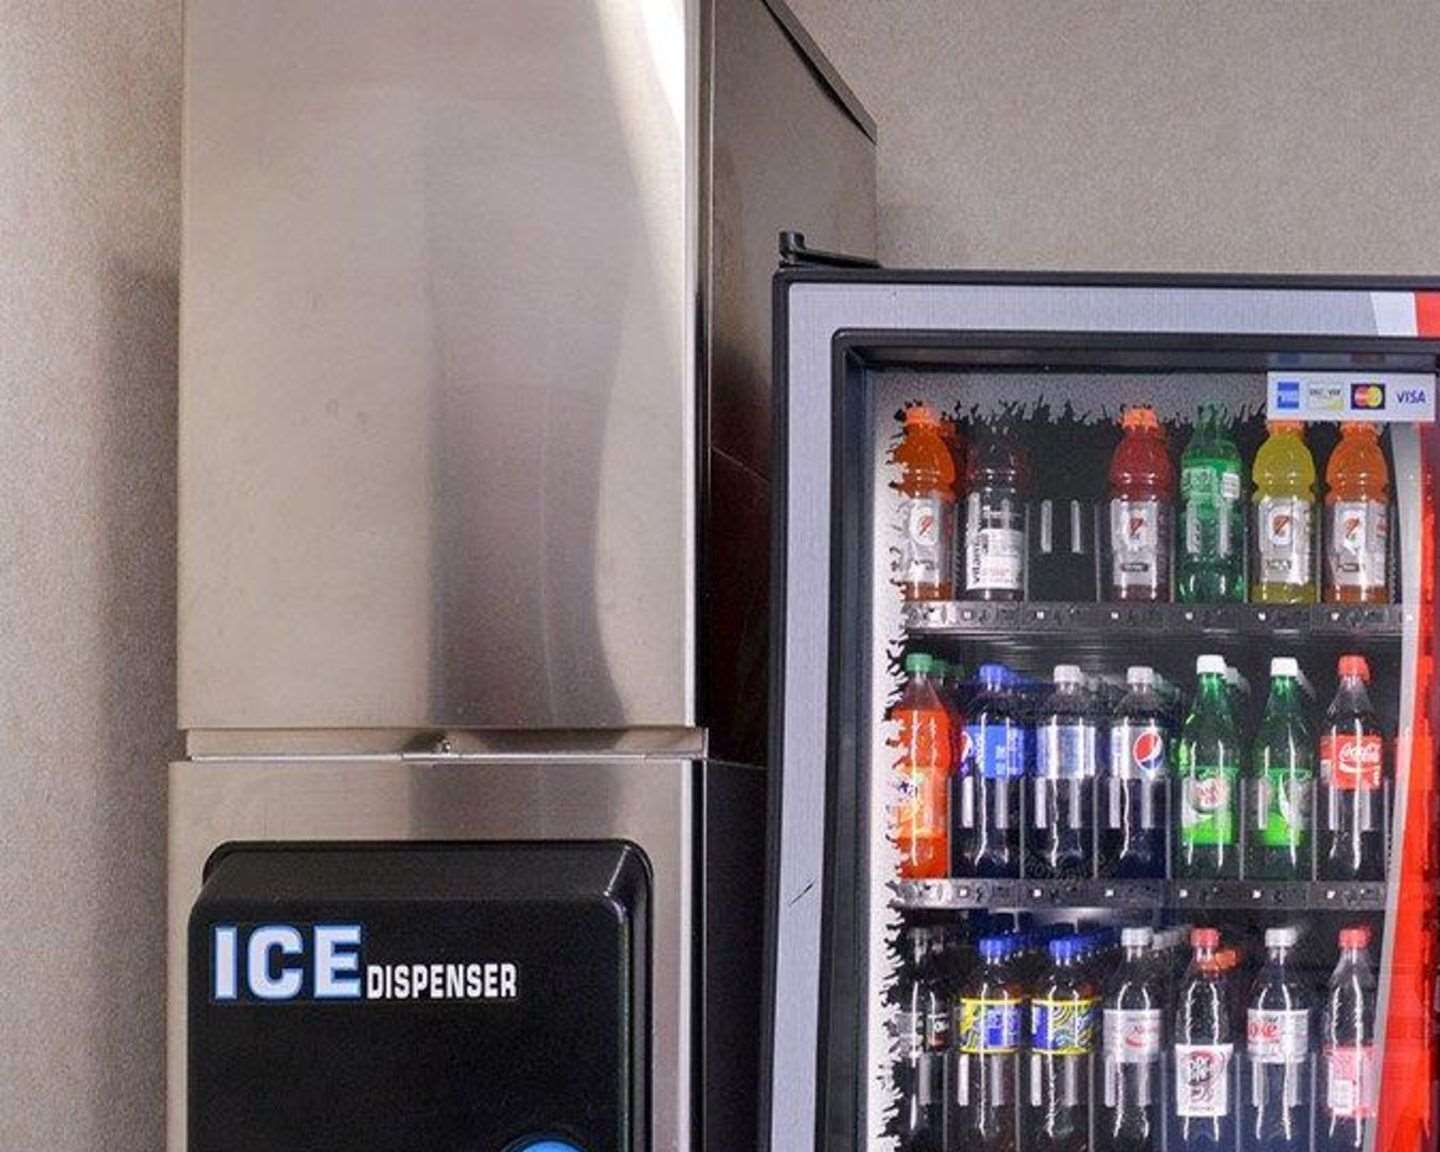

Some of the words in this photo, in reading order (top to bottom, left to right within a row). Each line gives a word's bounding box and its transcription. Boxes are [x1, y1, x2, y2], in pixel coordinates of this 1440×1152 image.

[1396, 388, 1426, 404] VISA
[213, 924, 363, 1000] ICE
[366, 962, 518, 999] DISPENSER
